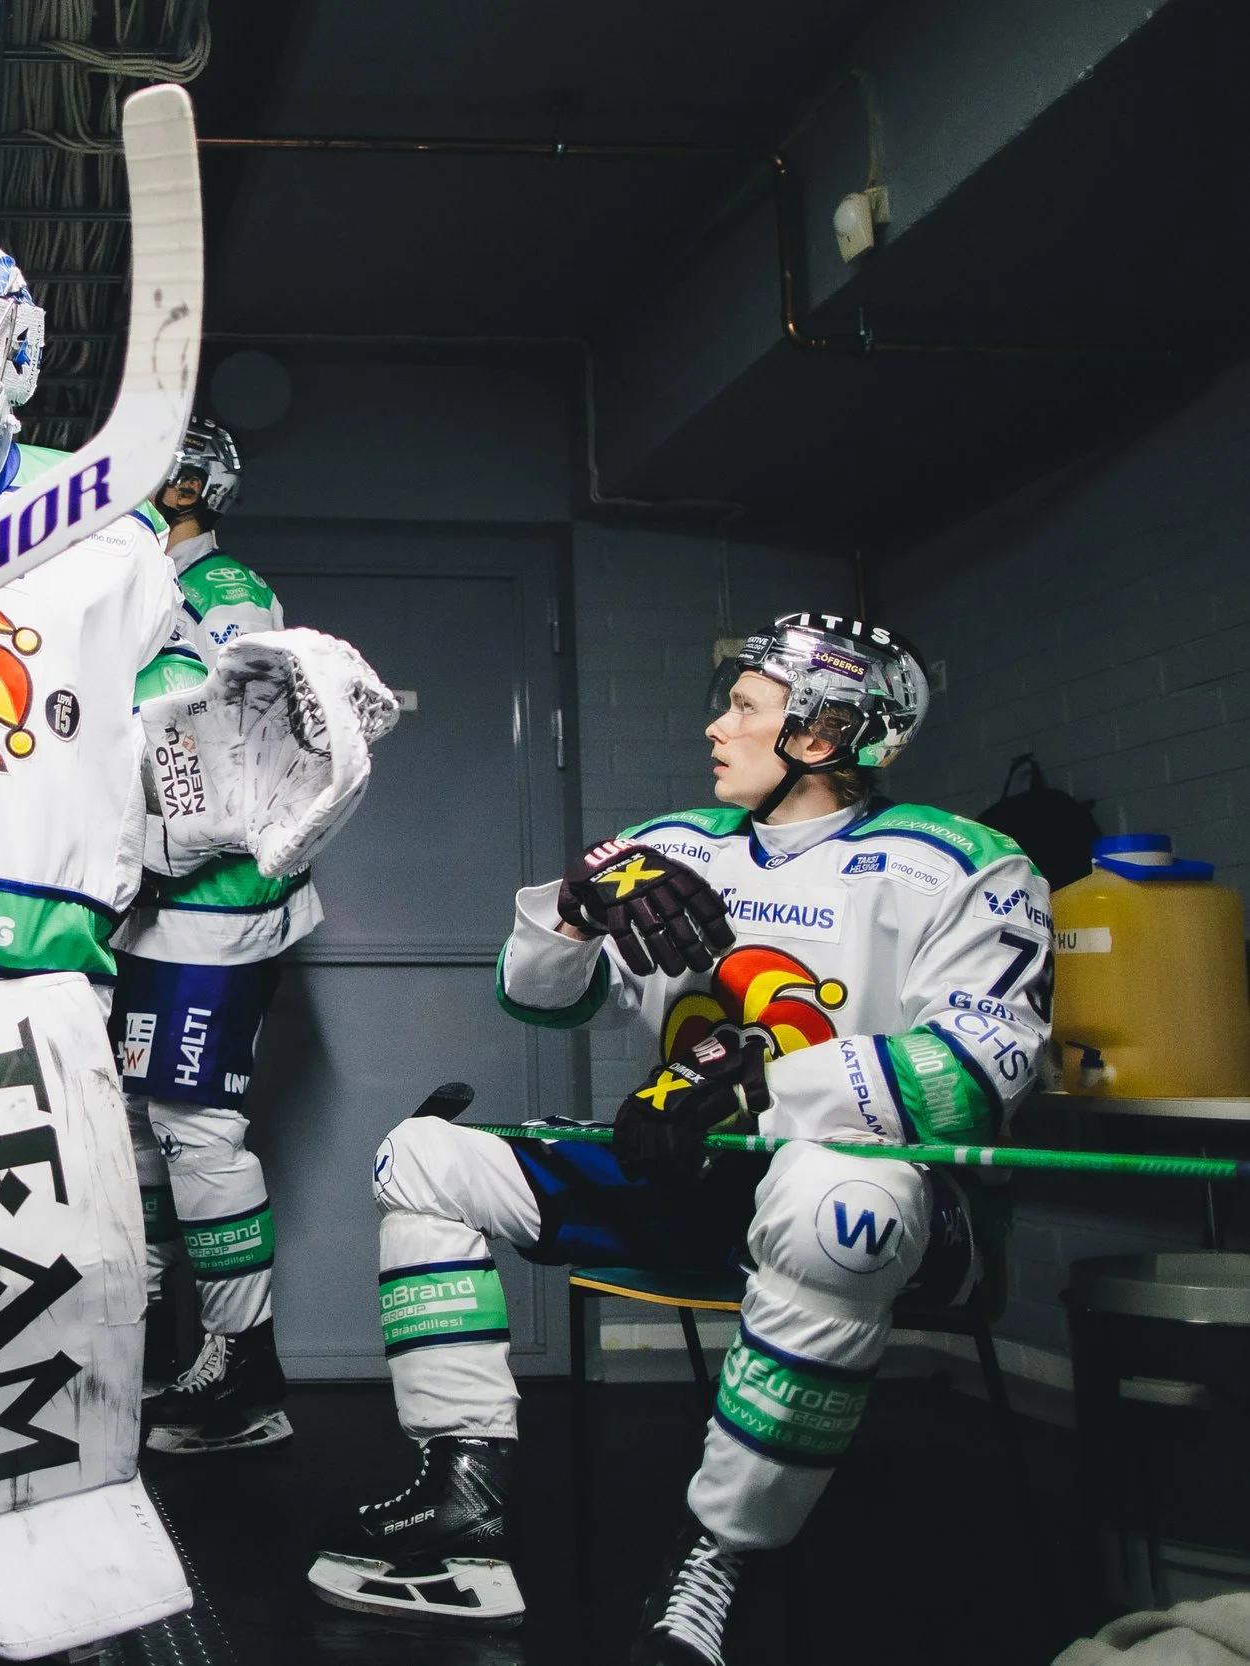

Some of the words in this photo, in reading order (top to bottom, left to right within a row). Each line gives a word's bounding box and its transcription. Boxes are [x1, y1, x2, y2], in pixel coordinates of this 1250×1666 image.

[815, 652, 865, 676] LÖFBERGS
[54, 704, 72, 734] 15
[156, 746, 180, 819] VALO
[165, 726, 194, 816] KUITU
[188, 755, 206, 812] NEN
[880, 819, 975, 851] ALEXANDRIA
[849, 862, 880, 873] HELSINKI
[857, 855, 878, 864] TAKSI
[891, 862, 913, 876] 0100
[915, 871, 938, 886] 0700
[728, 899, 835, 930] VEIKKAUS
[1055, 932, 1077, 949] HU
[174, 1007, 212, 1087] HALTI
[954, 1012, 1029, 1081] CHS
[668, 1062, 706, 1084] DIMEX
[838, 1039, 887, 1136] KATEPLAN
[832, 1199, 897, 1256] W
[382, 1304, 426, 1323] GROUP
[392, 1316, 463, 1338] Brändillesi
[384, 1508, 435, 1536] BAUER
